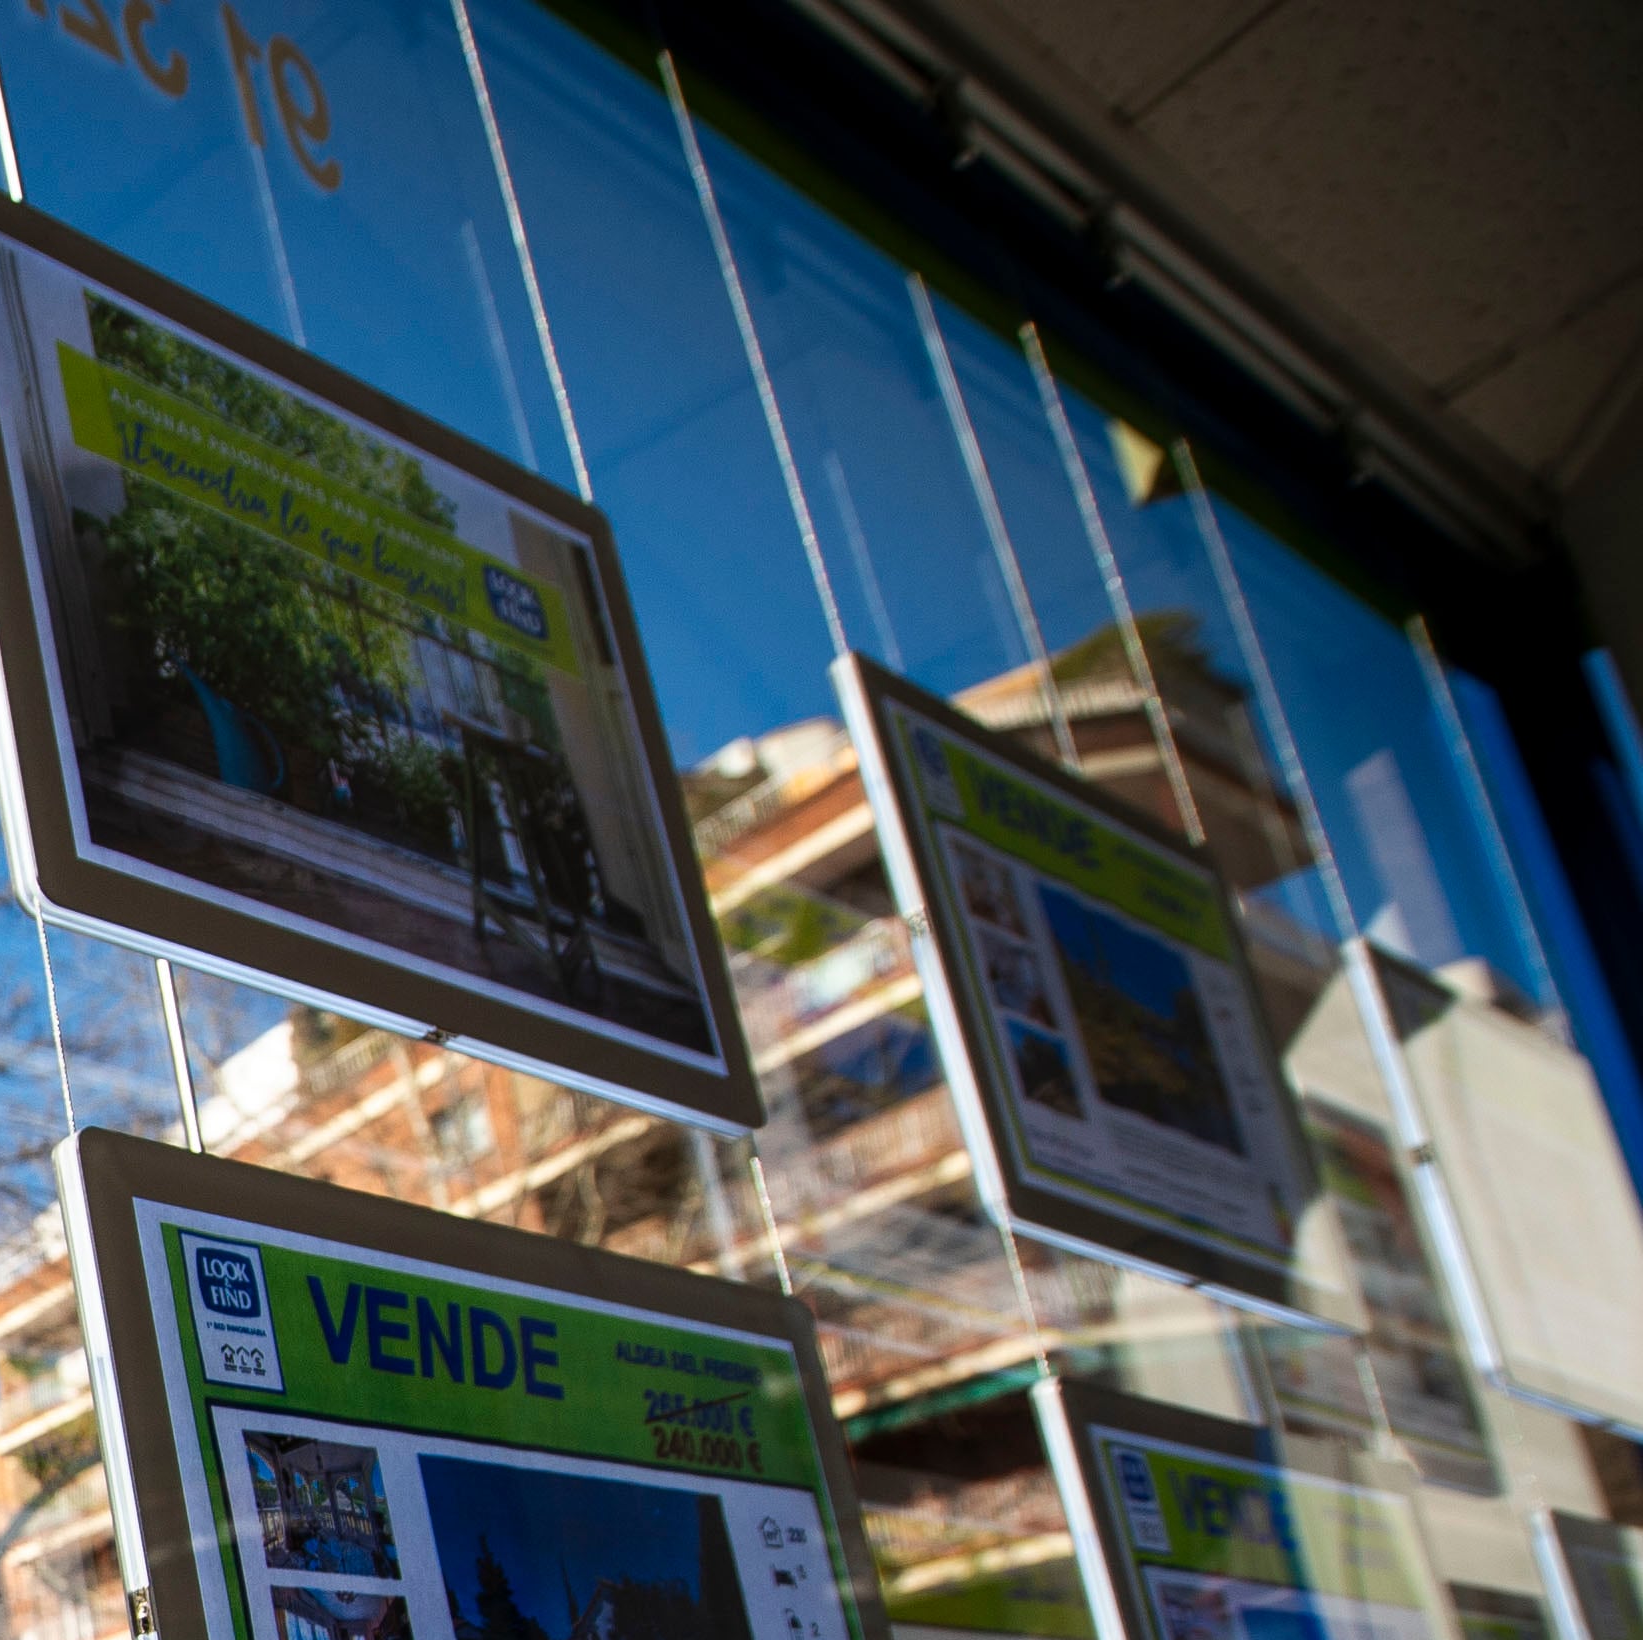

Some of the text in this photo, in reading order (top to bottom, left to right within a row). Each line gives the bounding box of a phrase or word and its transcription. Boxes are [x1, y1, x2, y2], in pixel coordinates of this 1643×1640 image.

[202, 1256, 251, 1283] LOOK
[210, 1284, 252, 1310] FIND
[306, 1273, 565, 1401] VENDE
